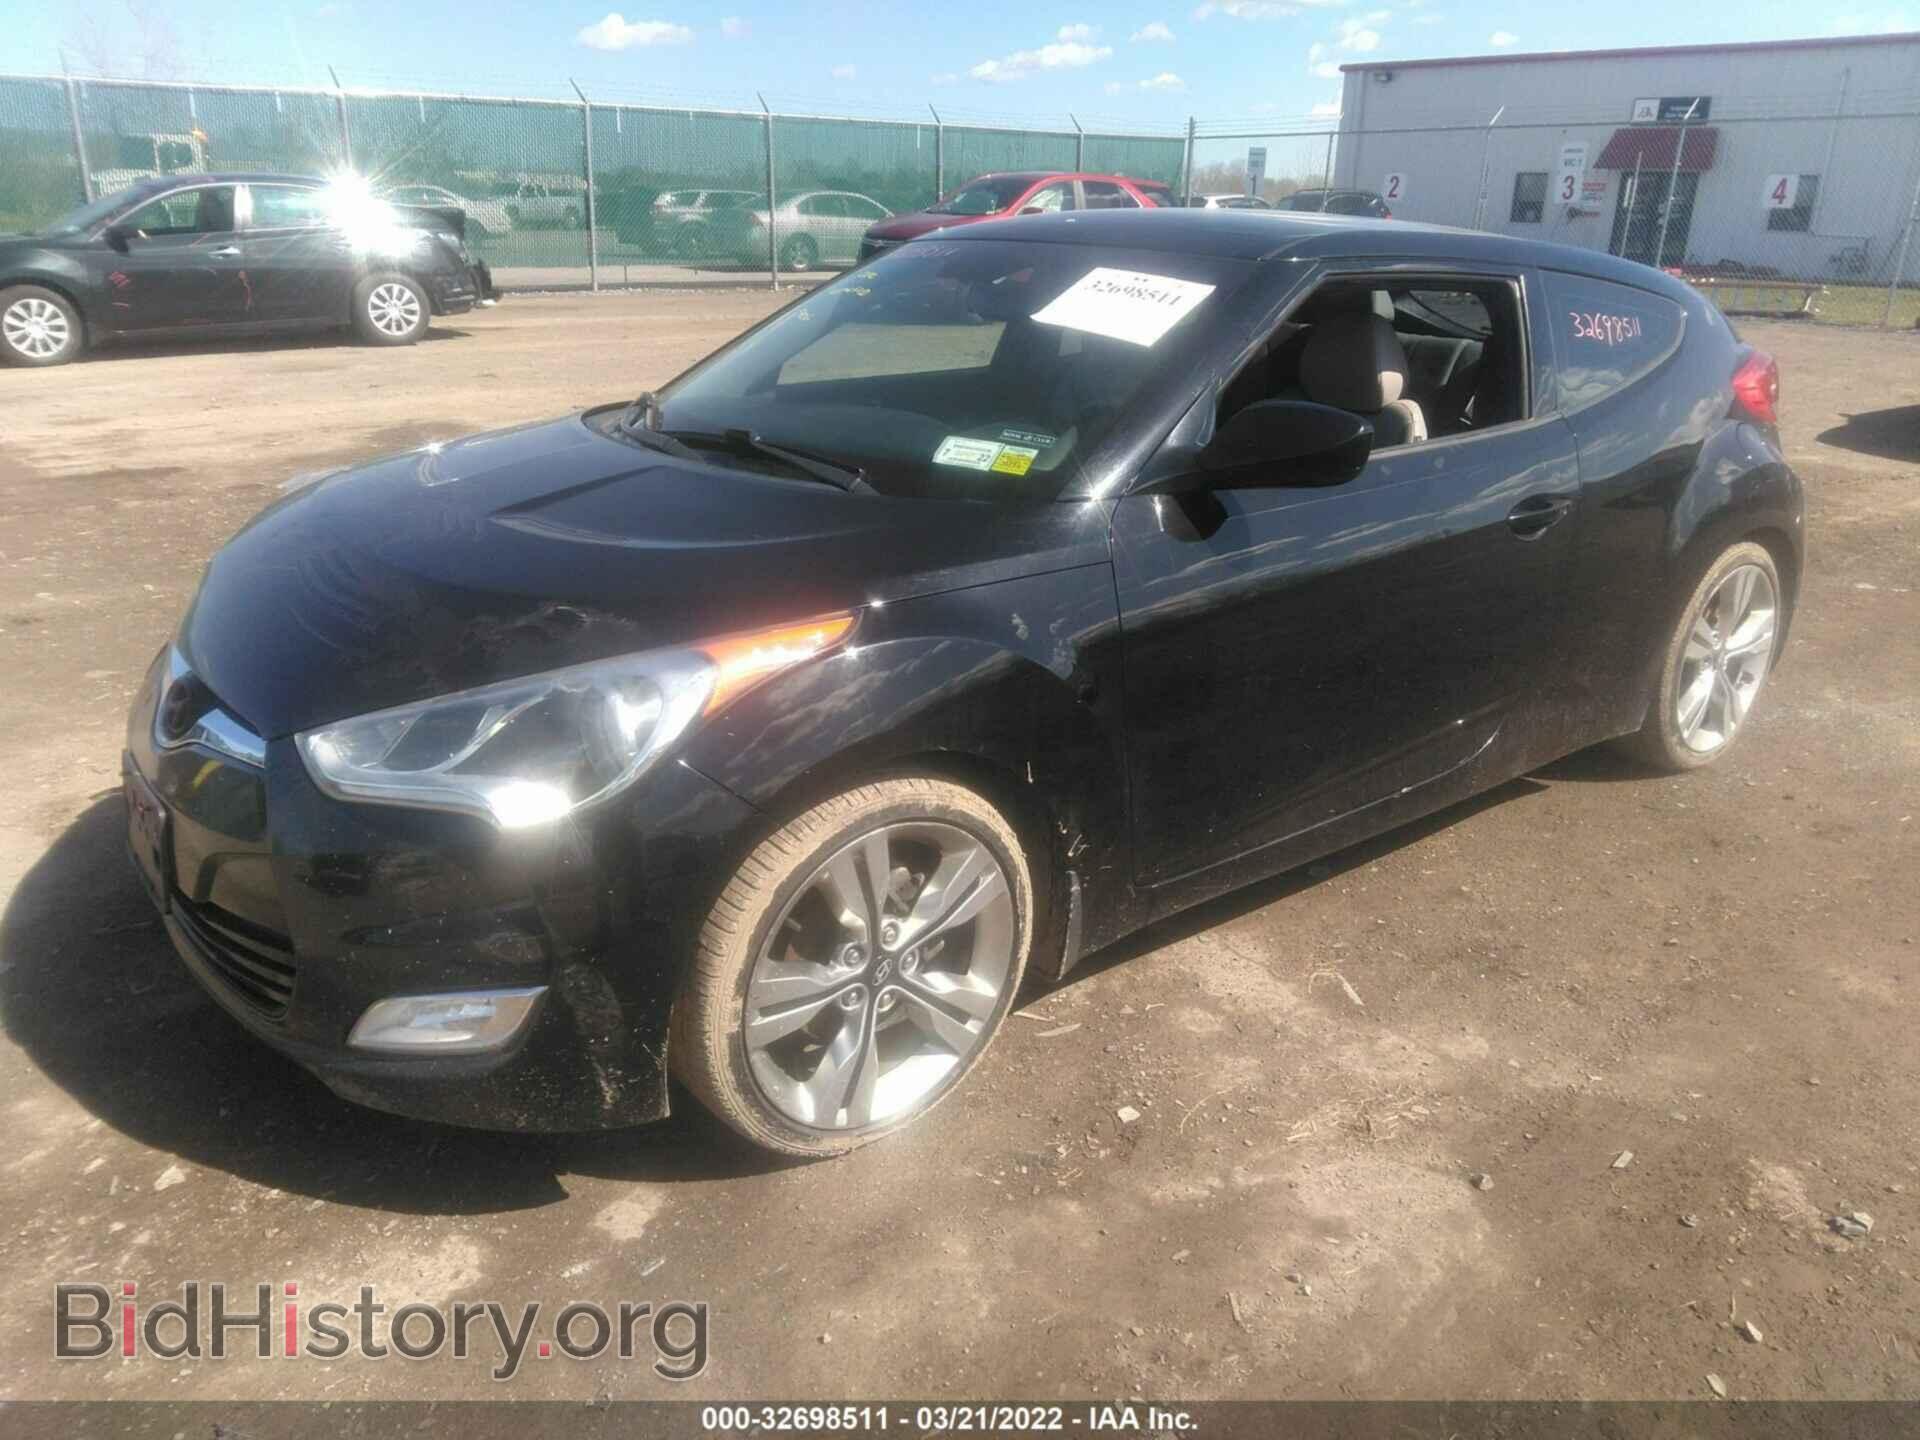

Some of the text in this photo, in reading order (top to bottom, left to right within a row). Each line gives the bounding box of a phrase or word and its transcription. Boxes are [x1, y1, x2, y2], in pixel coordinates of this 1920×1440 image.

[1388, 175, 1399, 198] 2
[1562, 175, 1574, 200] 3
[1771, 177, 1788, 205] 4
[1569, 312, 1641, 346] 32698511
